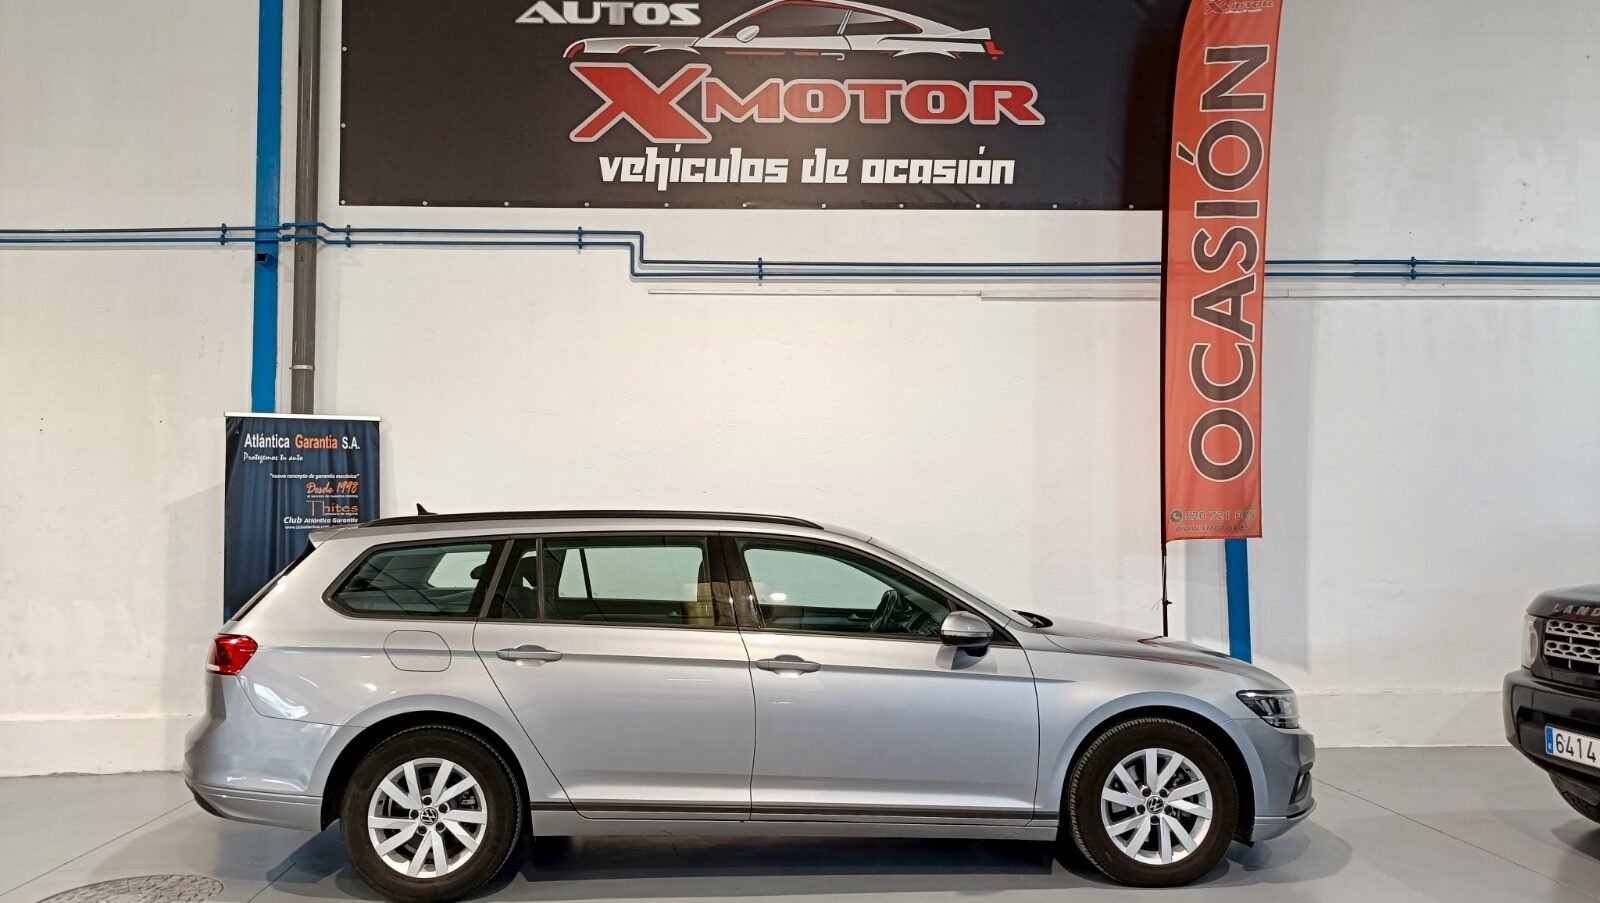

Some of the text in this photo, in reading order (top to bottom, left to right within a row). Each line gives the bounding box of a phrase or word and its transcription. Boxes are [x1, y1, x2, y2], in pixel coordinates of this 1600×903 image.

[515, 0, 701, 26] AUTOS
[599, 144, 1015, 191] vehículos de ocasión
[1176, 44, 1270, 482] OCASIÓN
[244, 433, 290, 449] Atlántica
[342, 436, 361, 449] S.A.
[243, 452, 304, 464] Protegemos tu auto
[306, 480, 359, 494] Desde 1998
[283, 516, 303, 524] Club
[1552, 603, 1600, 617] LAND
[1555, 732, 1597, 763] 6414
